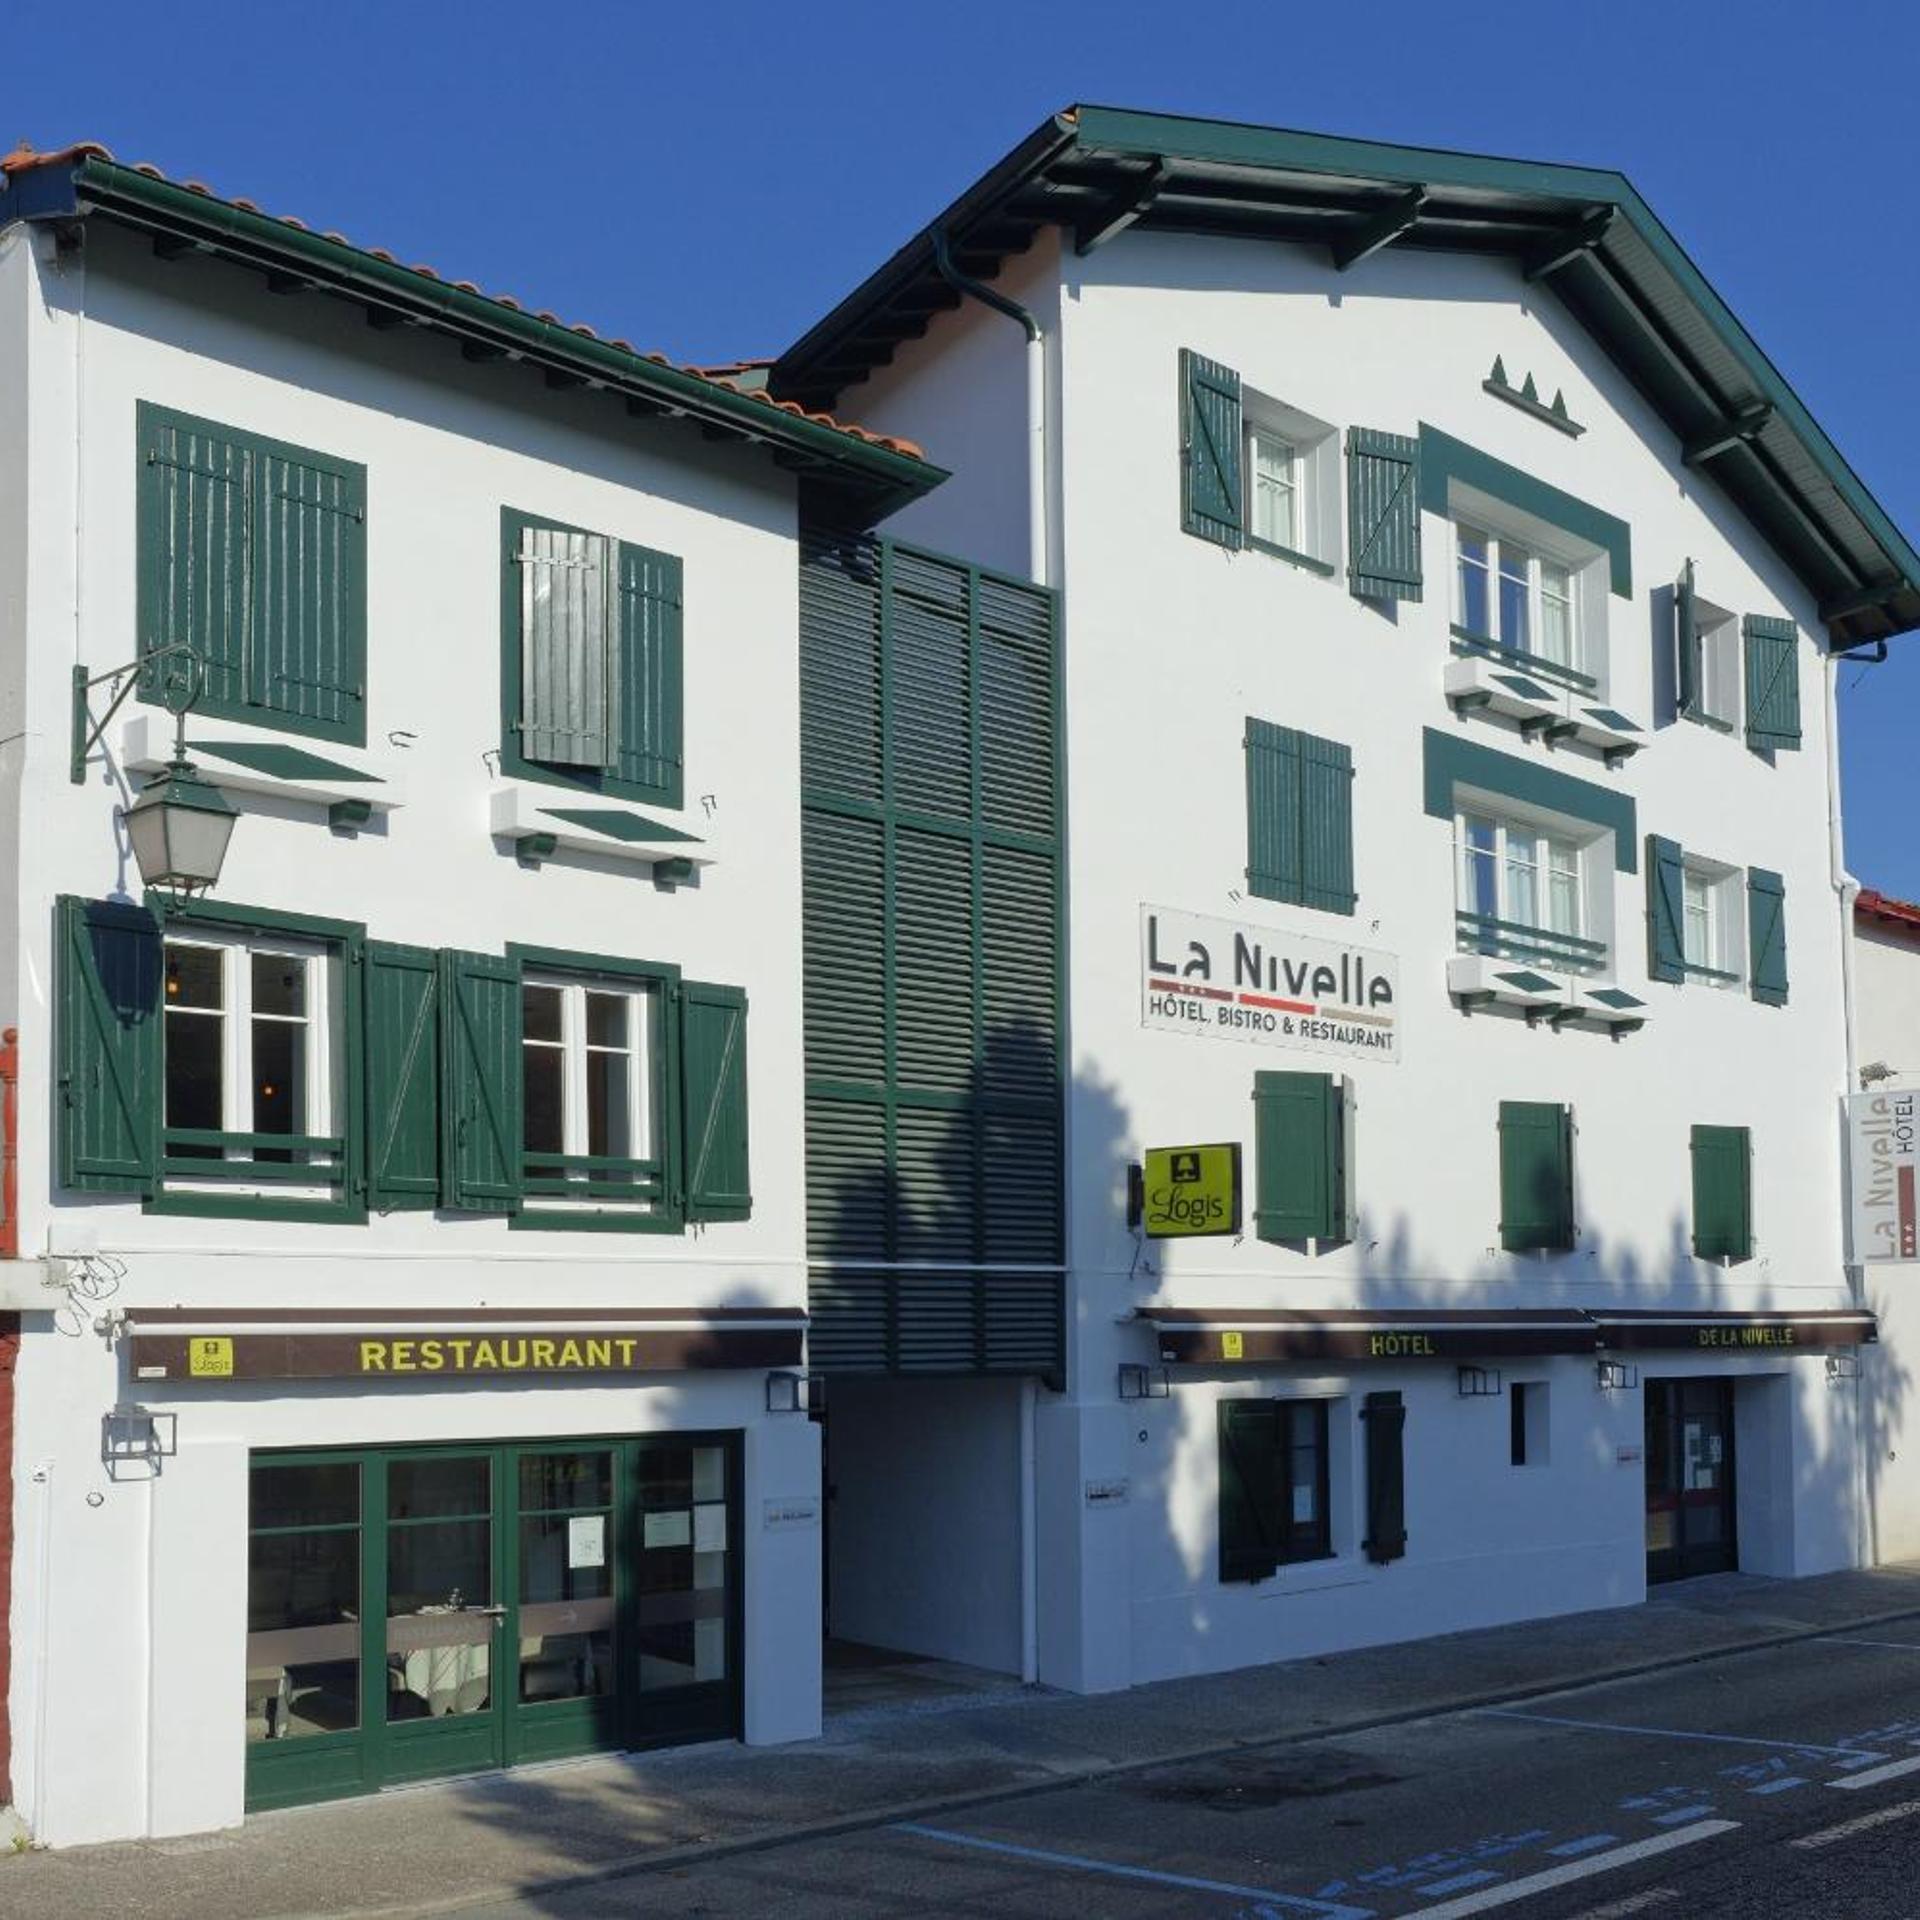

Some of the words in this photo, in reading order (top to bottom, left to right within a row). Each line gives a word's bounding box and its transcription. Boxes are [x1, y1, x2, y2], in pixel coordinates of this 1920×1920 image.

[1149, 915, 1210, 980] La
[1234, 932, 1393, 1008] Nivelle
[1149, 993, 1211, 1024] HÔTEL,
[1218, 1005, 1277, 1033] BISTRO
[1283, 1018, 1294, 1035] &
[1300, 1020, 1394, 1050] RESTAURANT
[1892, 1095, 1914, 1154] HÔTEL
[1861, 1096, 1894, 1207] Nivelle
[1149, 1184, 1225, 1229] Logis
[1865, 1220, 1896, 1260] La
[360, 1339, 638, 1371] RESTAURANT
[1371, 1330, 1436, 1355] HÔTEL
[1699, 1328, 1718, 1345] DE
[1720, 1328, 1738, 1345] LA
[1741, 1327, 1794, 1345] NIVELLE
